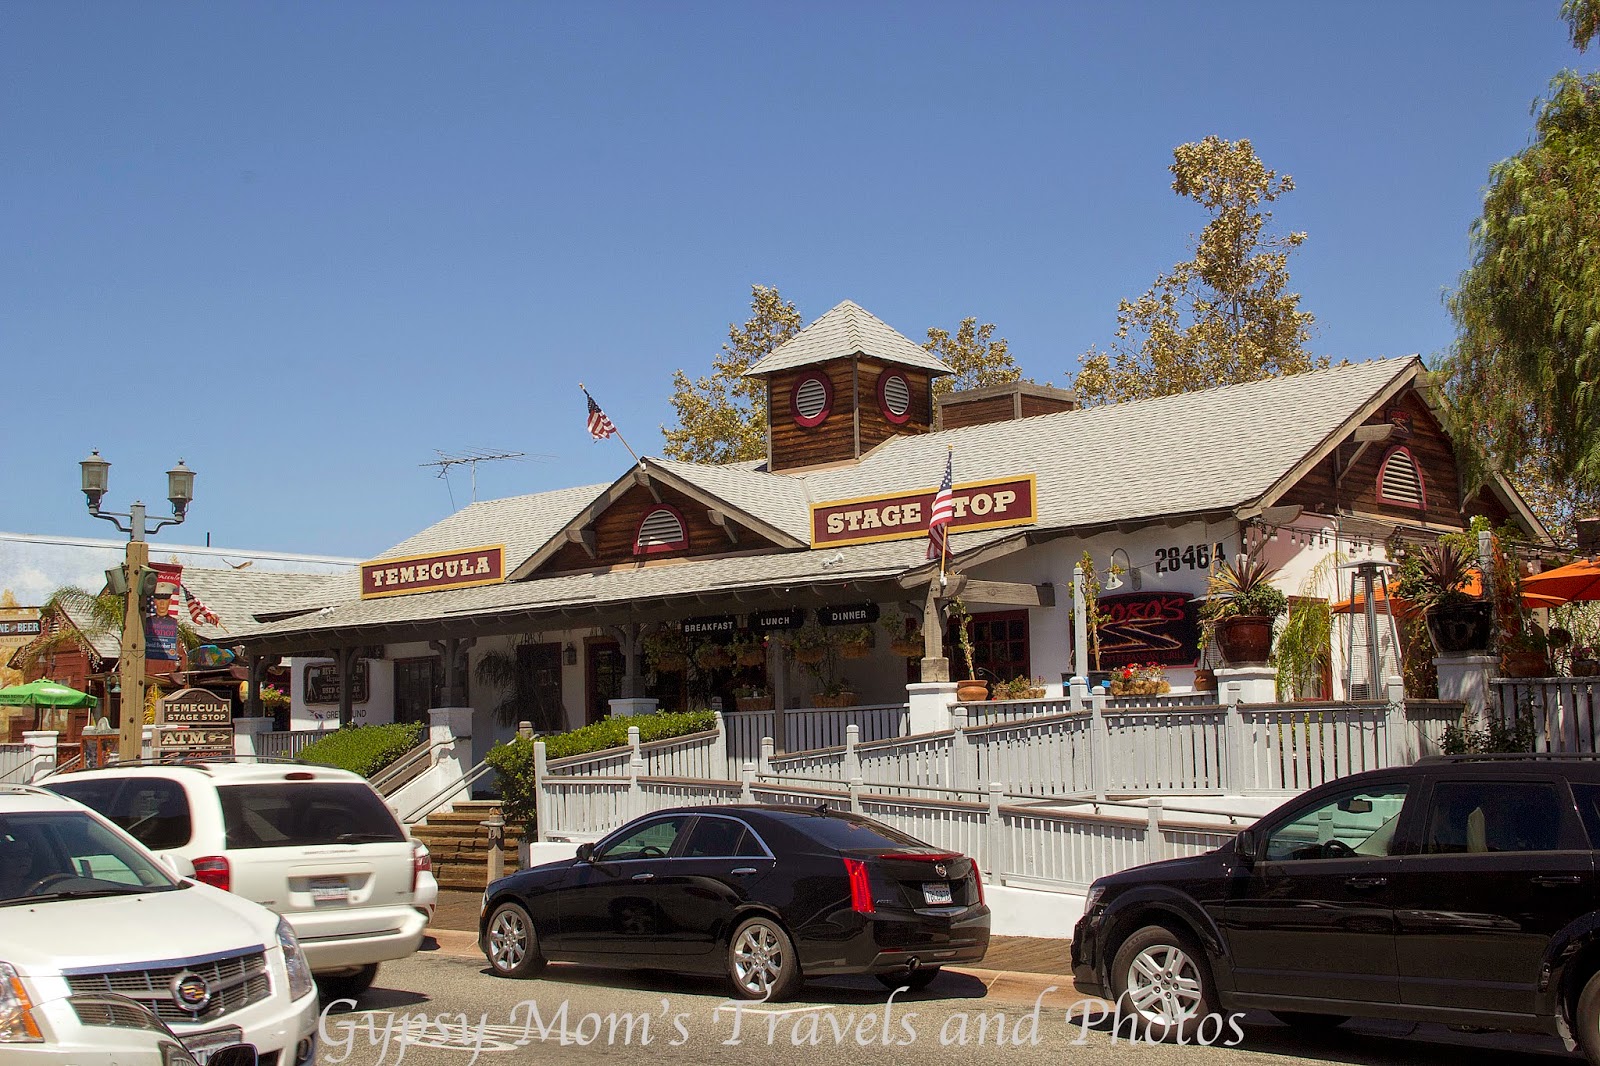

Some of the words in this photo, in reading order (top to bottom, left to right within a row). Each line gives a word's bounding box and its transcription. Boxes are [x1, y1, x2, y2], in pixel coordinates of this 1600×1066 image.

[827, 503, 921, 534] STAGE
[931, 490, 1017, 519] TOP
[1154, 542, 1226, 574] 28464
[372, 556, 491, 587] TEMECULA
[760, 616, 790, 626] LUNCH
[832, 610, 867, 621] DINNER
[17, 622, 40, 632] BEER
[684, 621, 734, 633] BREAKFAST
[165, 703, 228, 712] TEMECULA
[326, 709, 367, 719] GREUND
[162, 731, 207, 744] ATM
